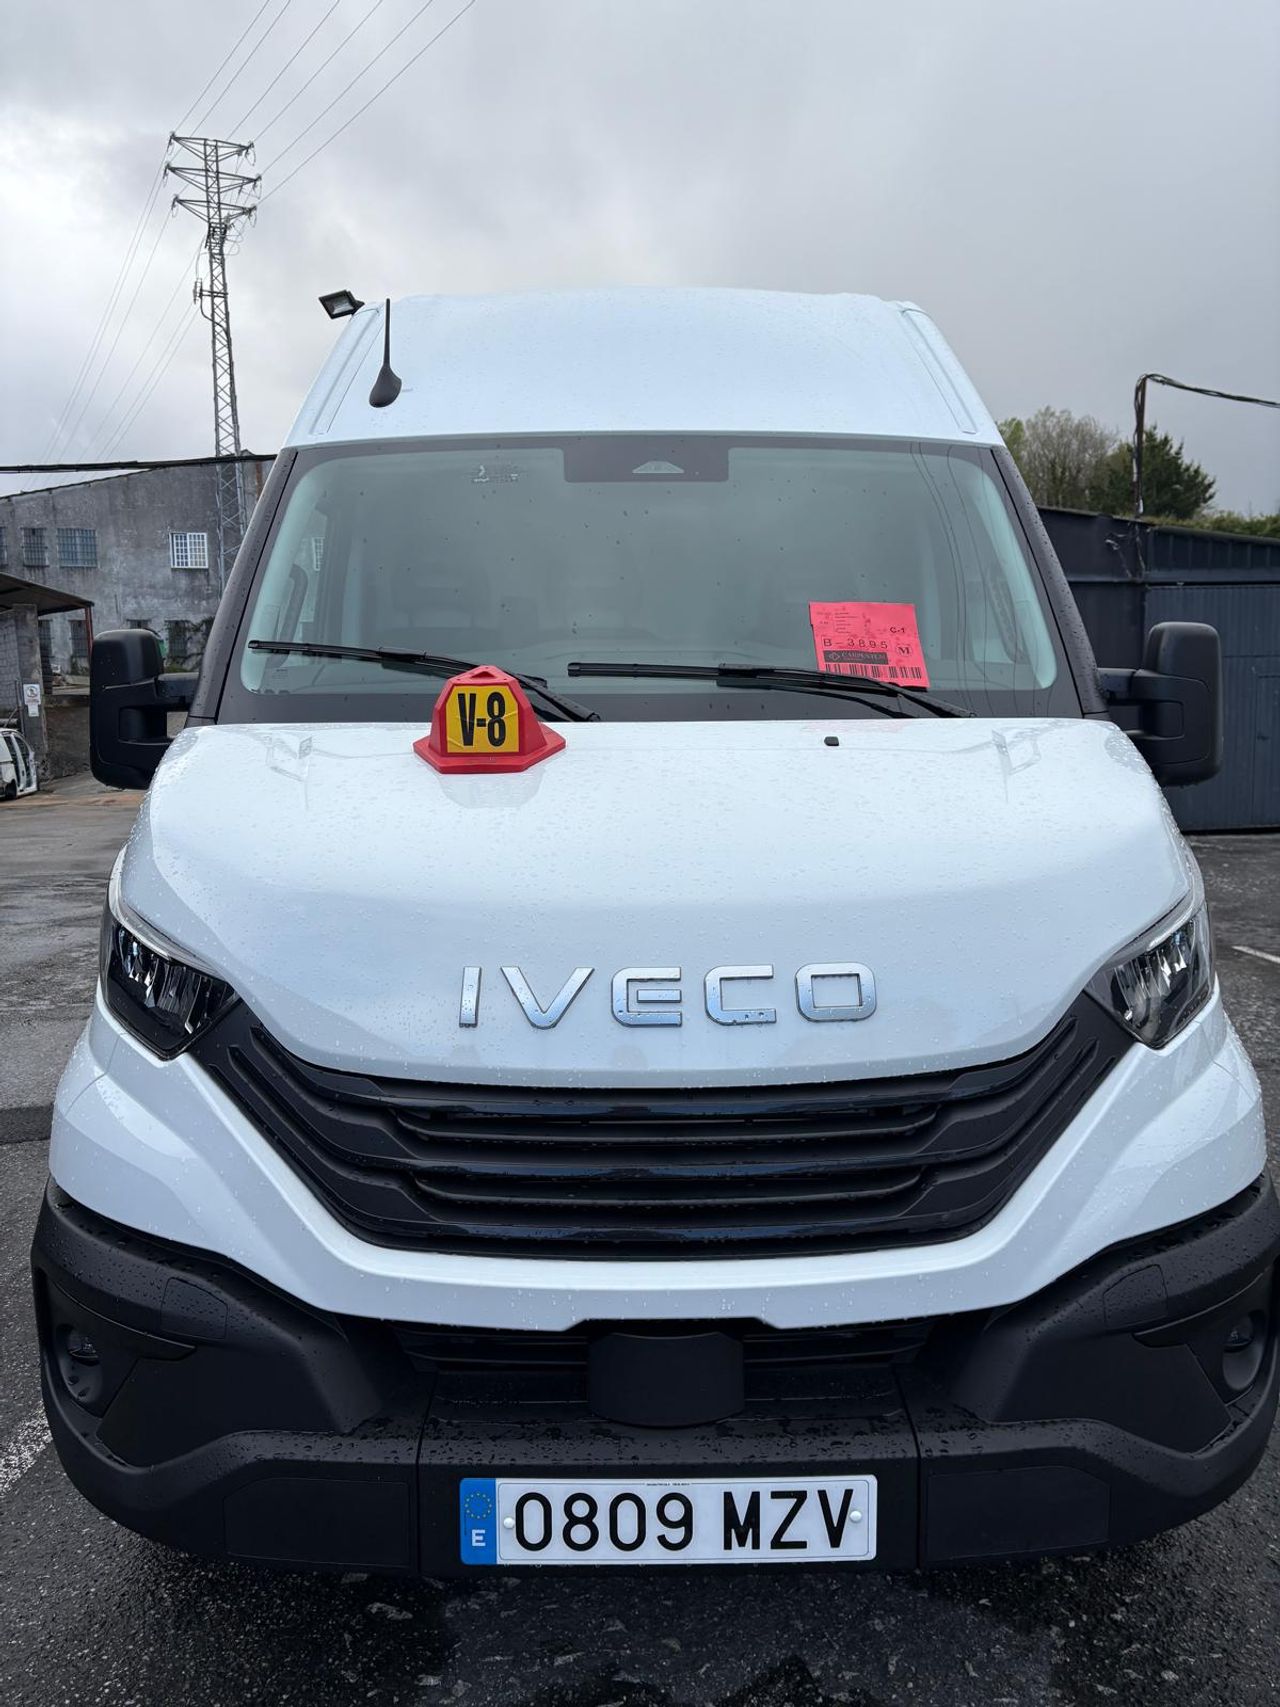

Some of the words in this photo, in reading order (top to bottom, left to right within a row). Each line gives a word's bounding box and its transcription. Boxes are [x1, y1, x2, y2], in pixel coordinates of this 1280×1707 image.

[457, 691, 506, 748] V-8
[458, 961, 878, 1029] IVECO
[471, 1529, 486, 1547] E
[514, 1491, 694, 1552] 0809
[723, 1488, 854, 1551] MZV
